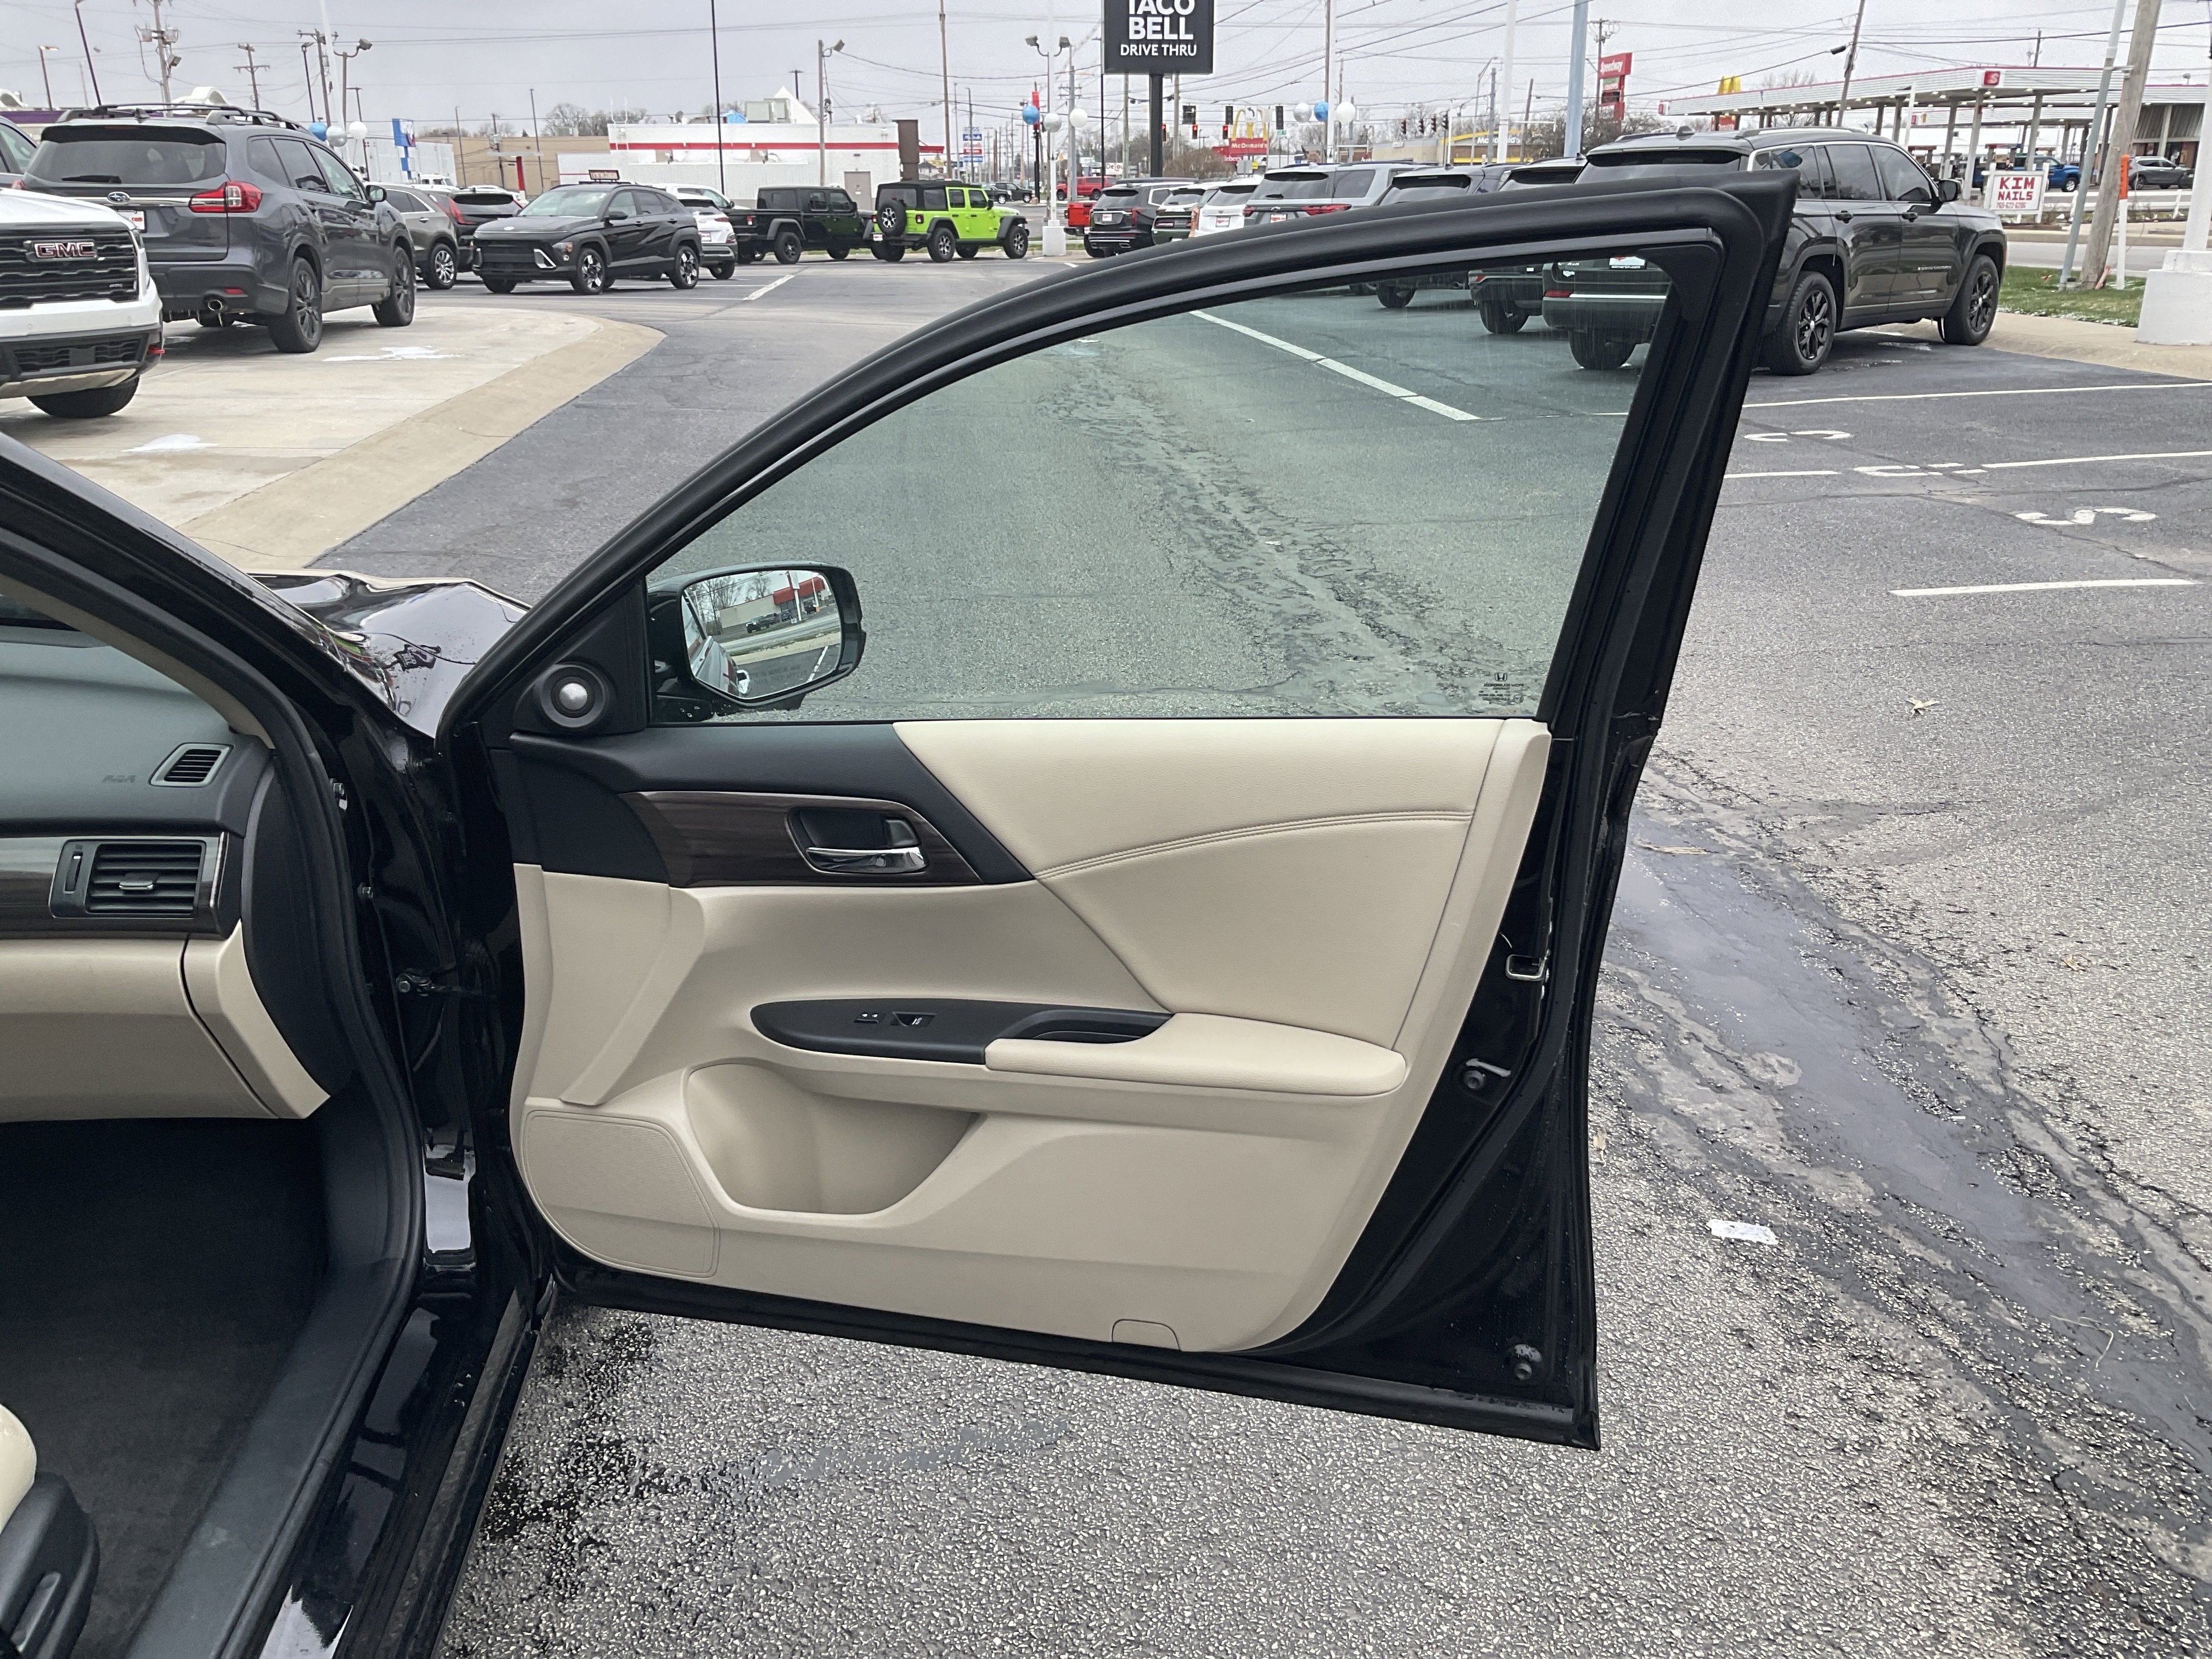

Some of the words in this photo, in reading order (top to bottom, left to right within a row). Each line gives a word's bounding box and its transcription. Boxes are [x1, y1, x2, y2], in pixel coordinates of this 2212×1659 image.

[1128, 16, 1194, 40] BELL
[1120, 44, 1159, 56] DRIVE
[1161, 44, 1197, 57] THRU
[1600, 60, 1623, 76] Speedway
[1477, 136, 1521, 144] Mcold's
[1999, 177, 2035, 190] KIM
[1997, 191, 2033, 201] NAILS
[35, 242, 95, 258] GMC
